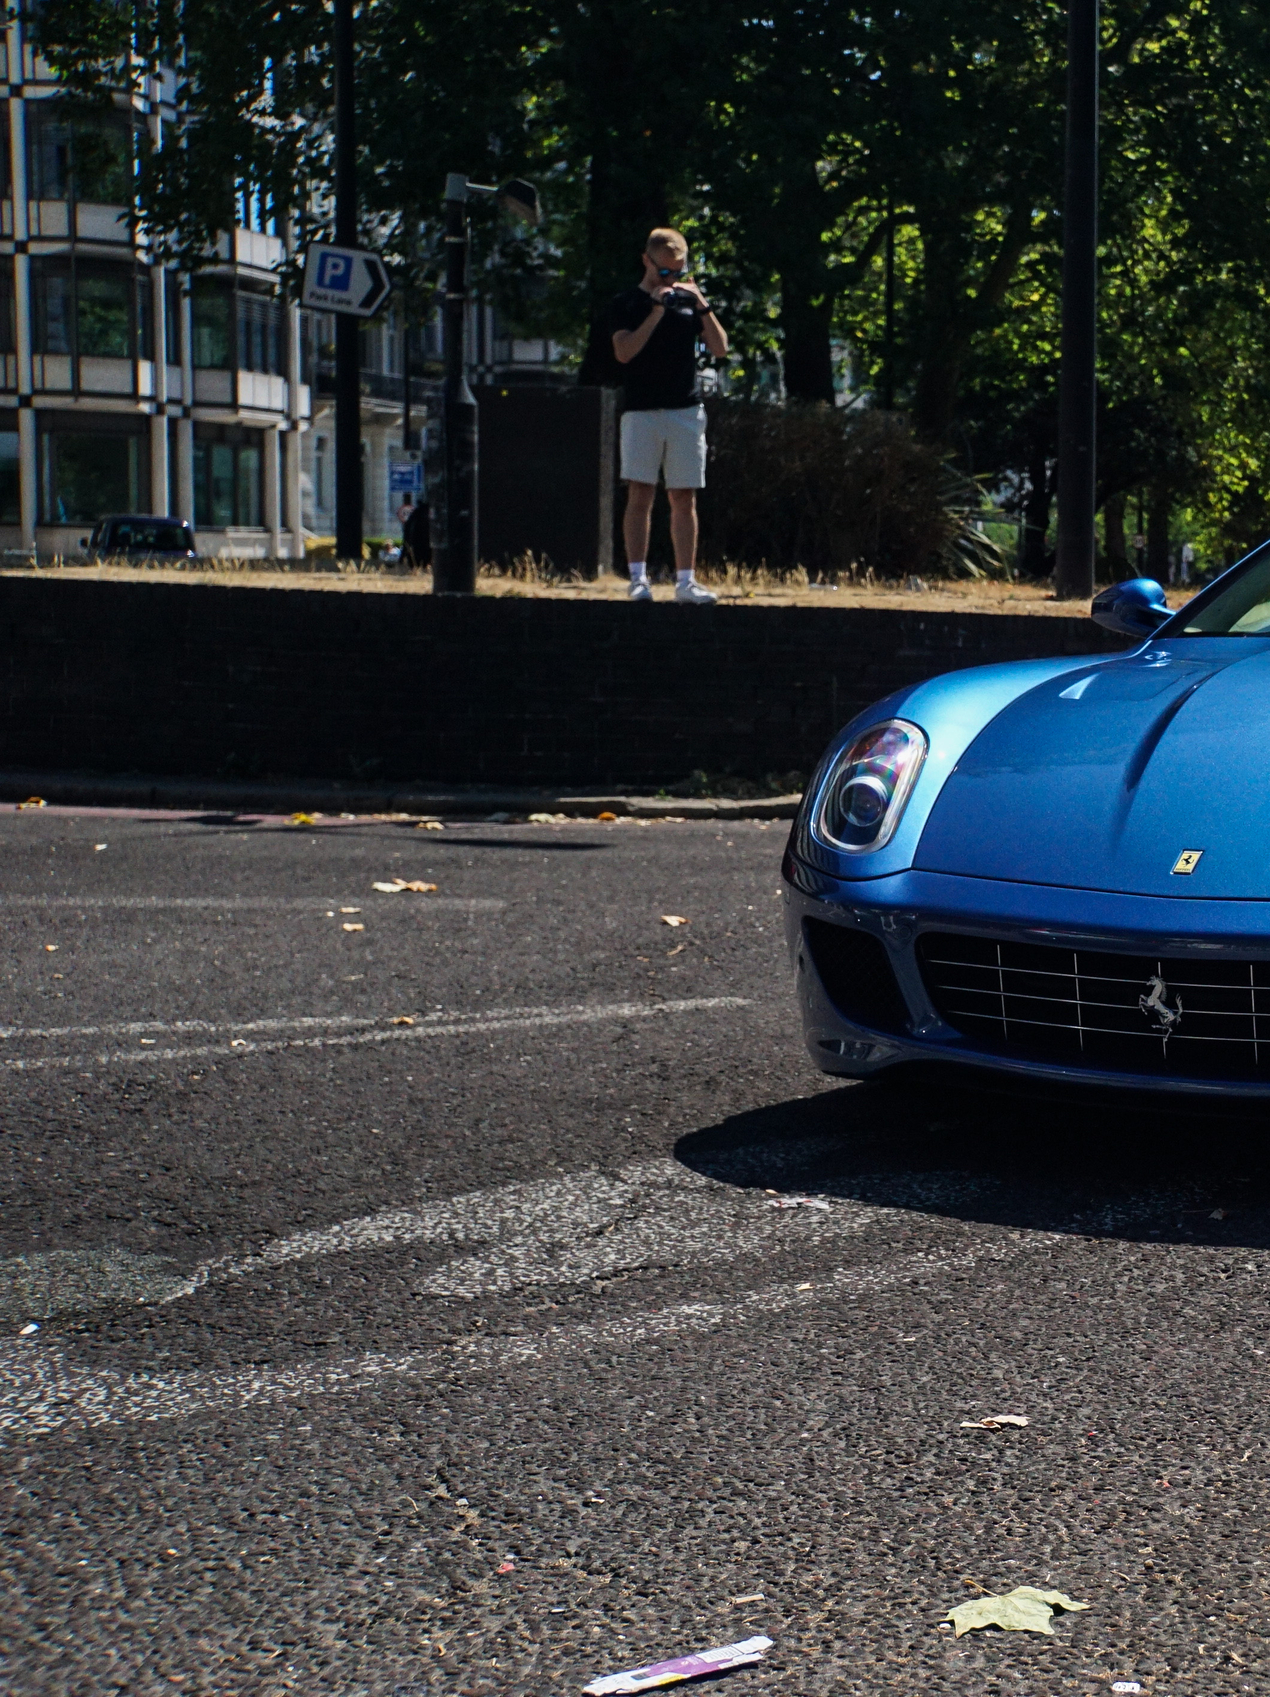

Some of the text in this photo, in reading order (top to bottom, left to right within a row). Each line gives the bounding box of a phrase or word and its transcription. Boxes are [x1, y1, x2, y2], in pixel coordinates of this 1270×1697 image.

[323, 256, 346, 286] P
[309, 291, 353, 306] Park Lane
